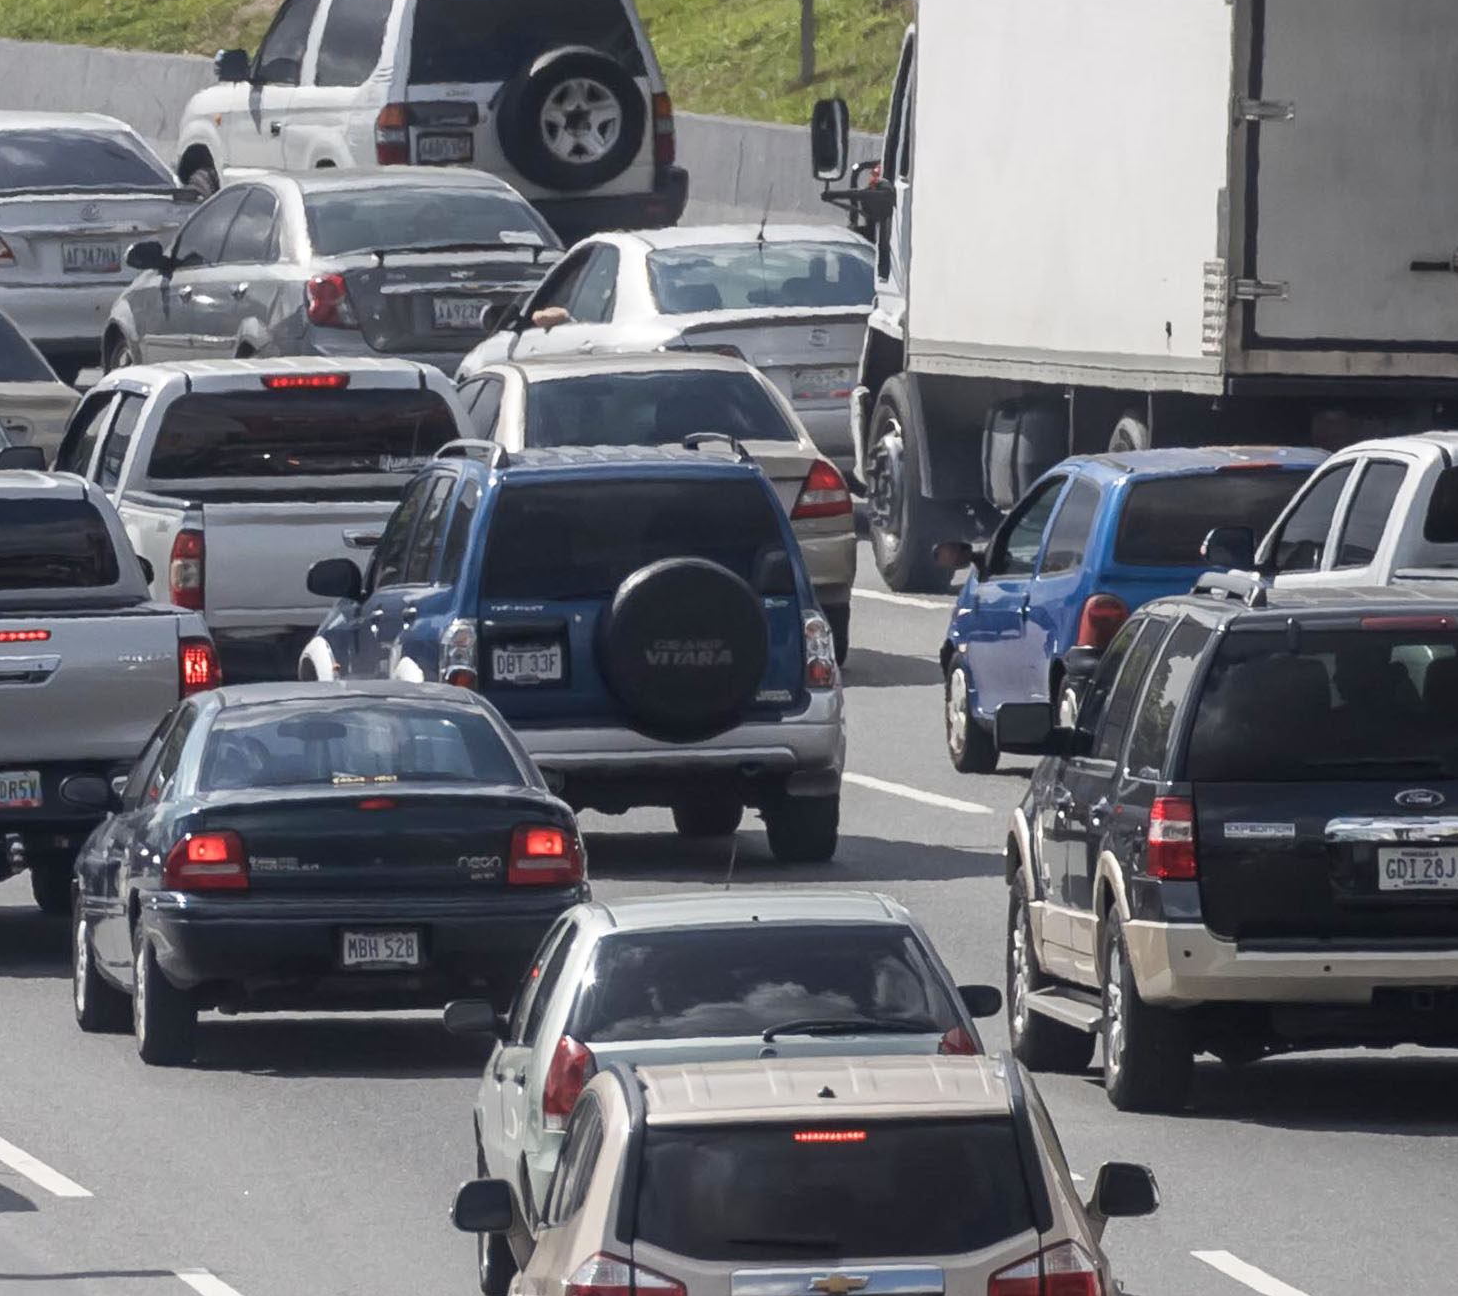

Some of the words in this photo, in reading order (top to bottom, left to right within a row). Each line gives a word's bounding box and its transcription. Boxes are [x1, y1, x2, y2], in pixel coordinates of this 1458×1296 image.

[497, 653, 528, 675] DBT
[530, 652, 557, 674] 33F
[644, 648, 734, 666] VITARA
[457, 856, 502, 869] neon
[1386, 858, 1417, 880] GDI
[1423, 857, 1456, 879] 28J
[348, 937, 379, 959] MBH
